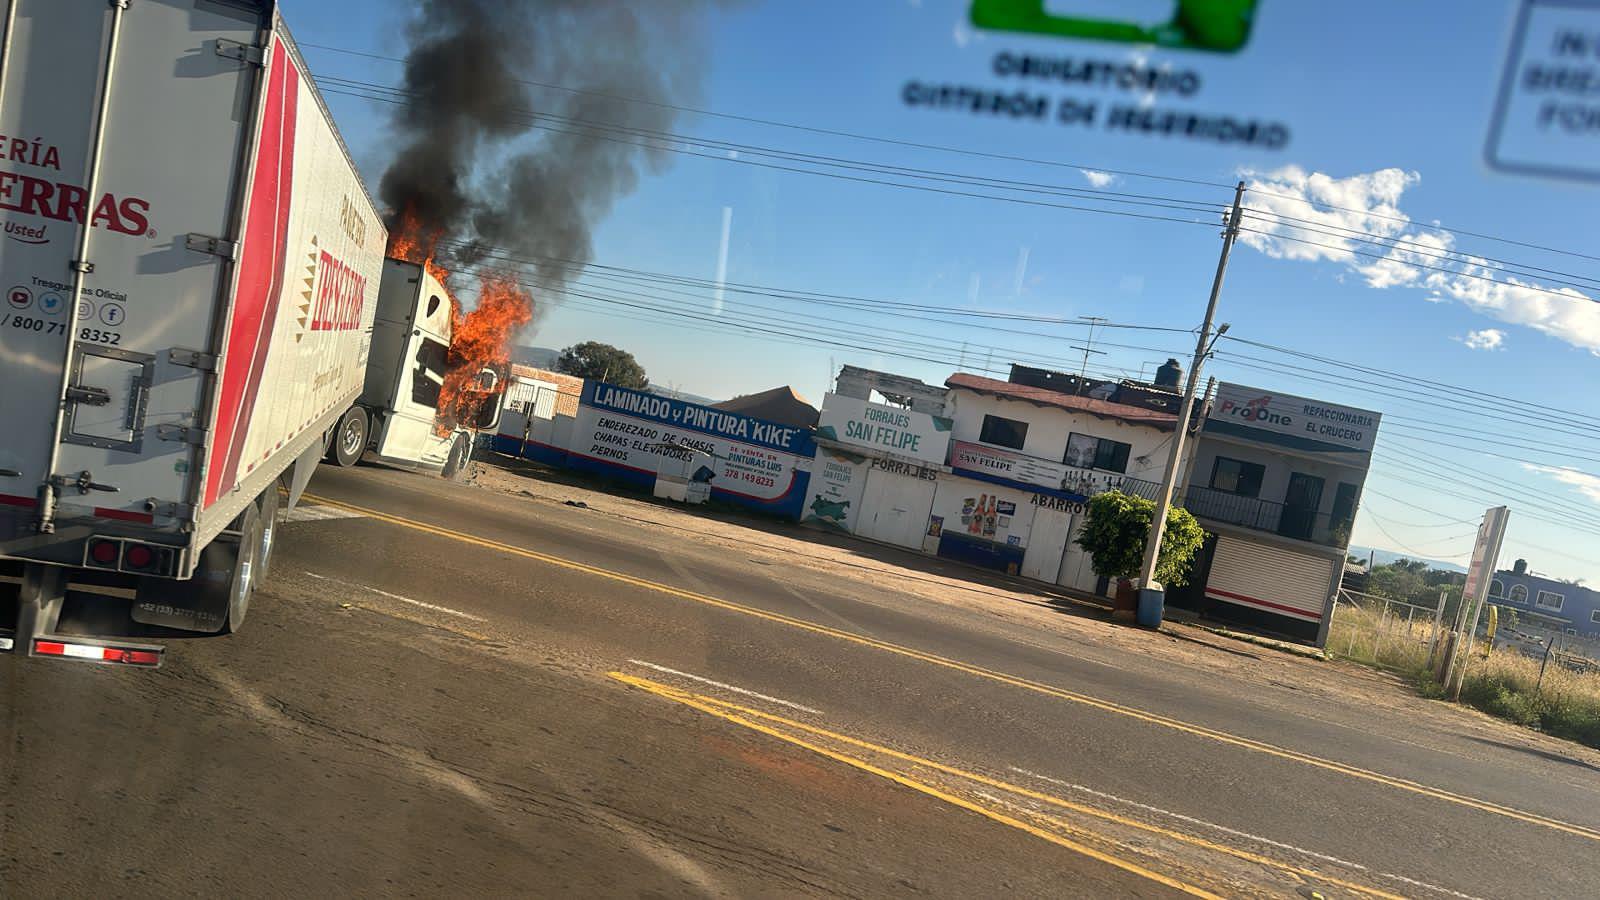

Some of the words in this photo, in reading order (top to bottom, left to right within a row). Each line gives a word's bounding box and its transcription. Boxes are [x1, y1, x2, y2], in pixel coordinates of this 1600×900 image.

[4, 221, 47, 239] Usted
[95, 288, 127, 302] Oficial
[12, 316, 43, 331] 800
[80, 328, 121, 345] 8352
[594, 385, 671, 419] LAMINADO
[682, 406, 748, 438] PINTURA
[864, 407, 911, 428] FORRAJES
[1303, 404, 1373, 427] REFACCIONARIA
[598, 417, 658, 440] ENDEREZADO
[662, 433, 677, 444] DE
[680, 437, 715, 454] CHASIS
[845, 420, 874, 442] SAN
[875, 427, 921, 452] FELIPE
[1306, 422, 1317, 433] EL
[1319, 424, 1363, 442] CRUCERO
[590, 444, 628, 461] PERNOS
[594, 431, 628, 447] CHAPAS
[632, 440, 694, 463] ELEVADORES
[742, 449, 764, 458] VENTA
[728, 452, 765, 469] PINTURAS
[766, 461, 782, 472] LUIS
[871, 457, 938, 481] FORRAJES
[959, 453, 977, 464] SAN
[979, 457, 1013, 472] FELIPE
[724, 468, 739, 480] 378
